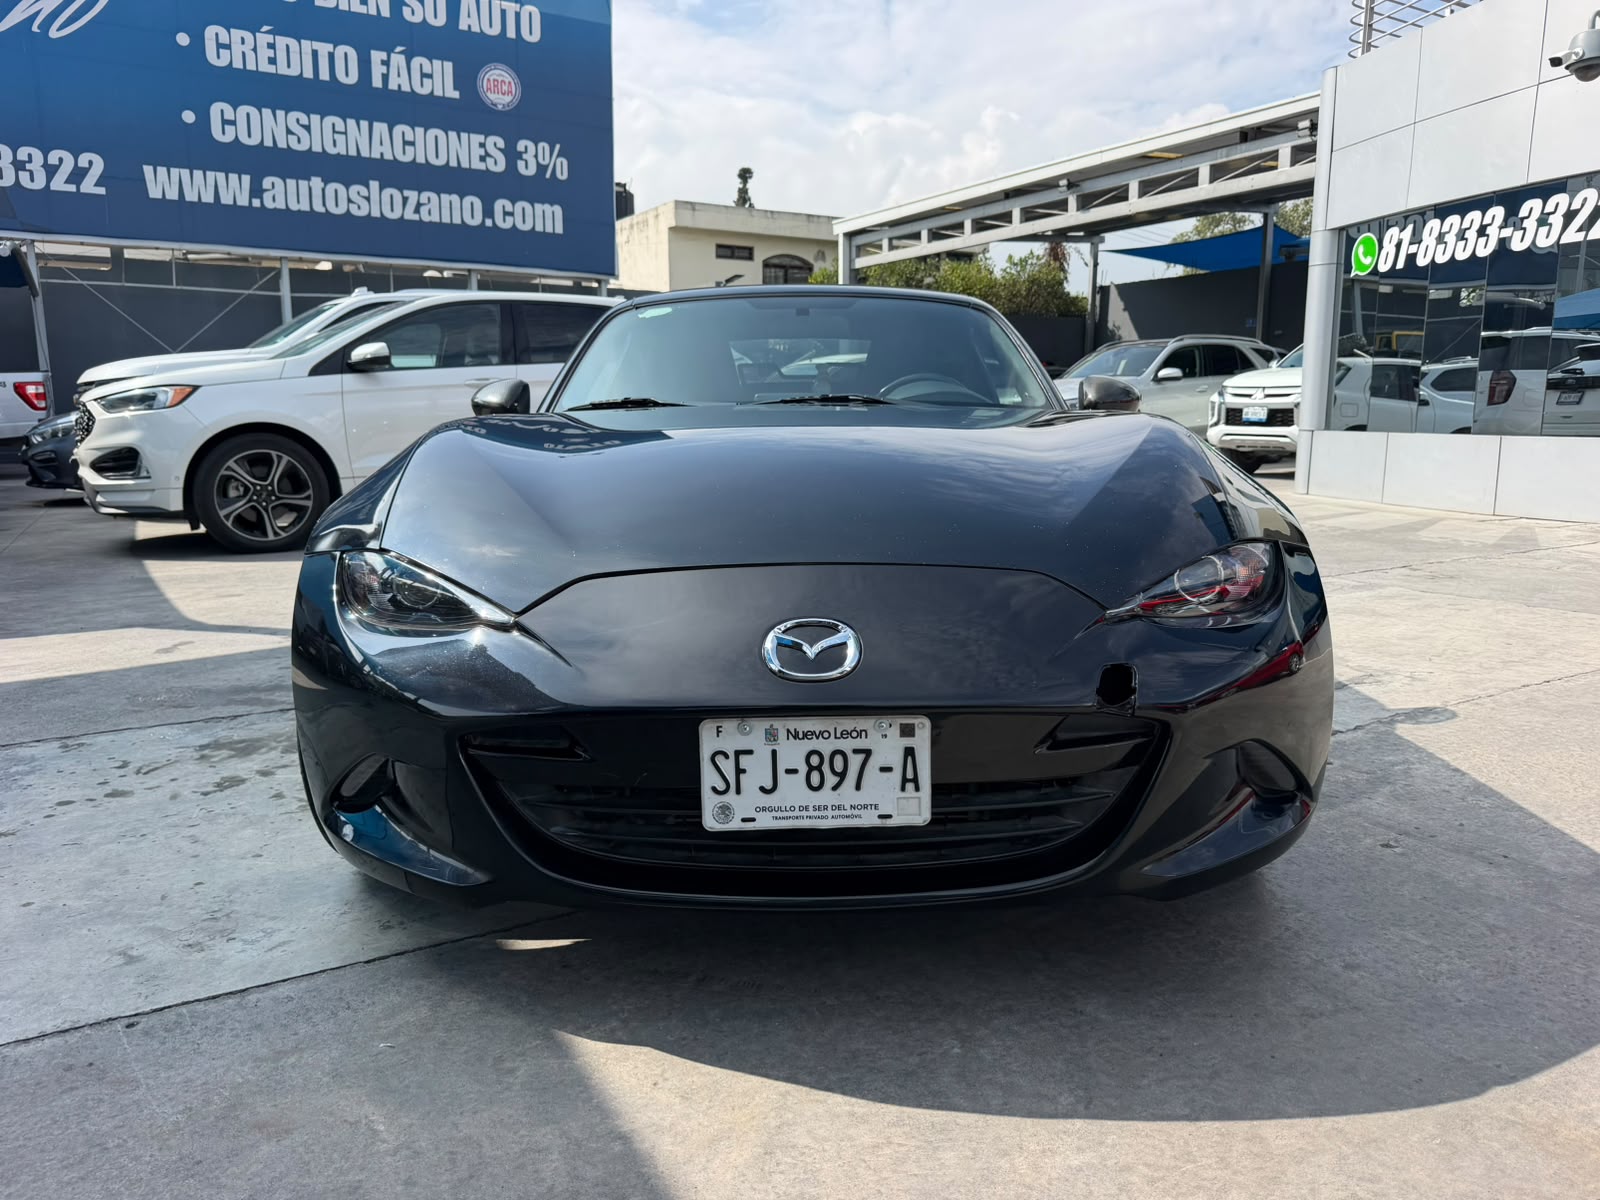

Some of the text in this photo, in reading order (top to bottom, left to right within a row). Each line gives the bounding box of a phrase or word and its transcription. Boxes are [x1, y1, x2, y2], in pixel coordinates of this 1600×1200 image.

[458, 0, 542, 43] AUTO
[204, 25, 460, 100] CRÉDITO FÁCIL
[486, 78, 514, 97] ARCA
[209, 102, 569, 181] CONSIGNACIONES 3%
[142, 164, 564, 235] www.autoslozano.com
[716, 725, 723, 738] F
[786, 727, 868, 741] Nuevo León
[710, 746, 921, 796] SFJ-897-A
[755, 803, 880, 813] ORGULLO DE SER DEL NORTE
